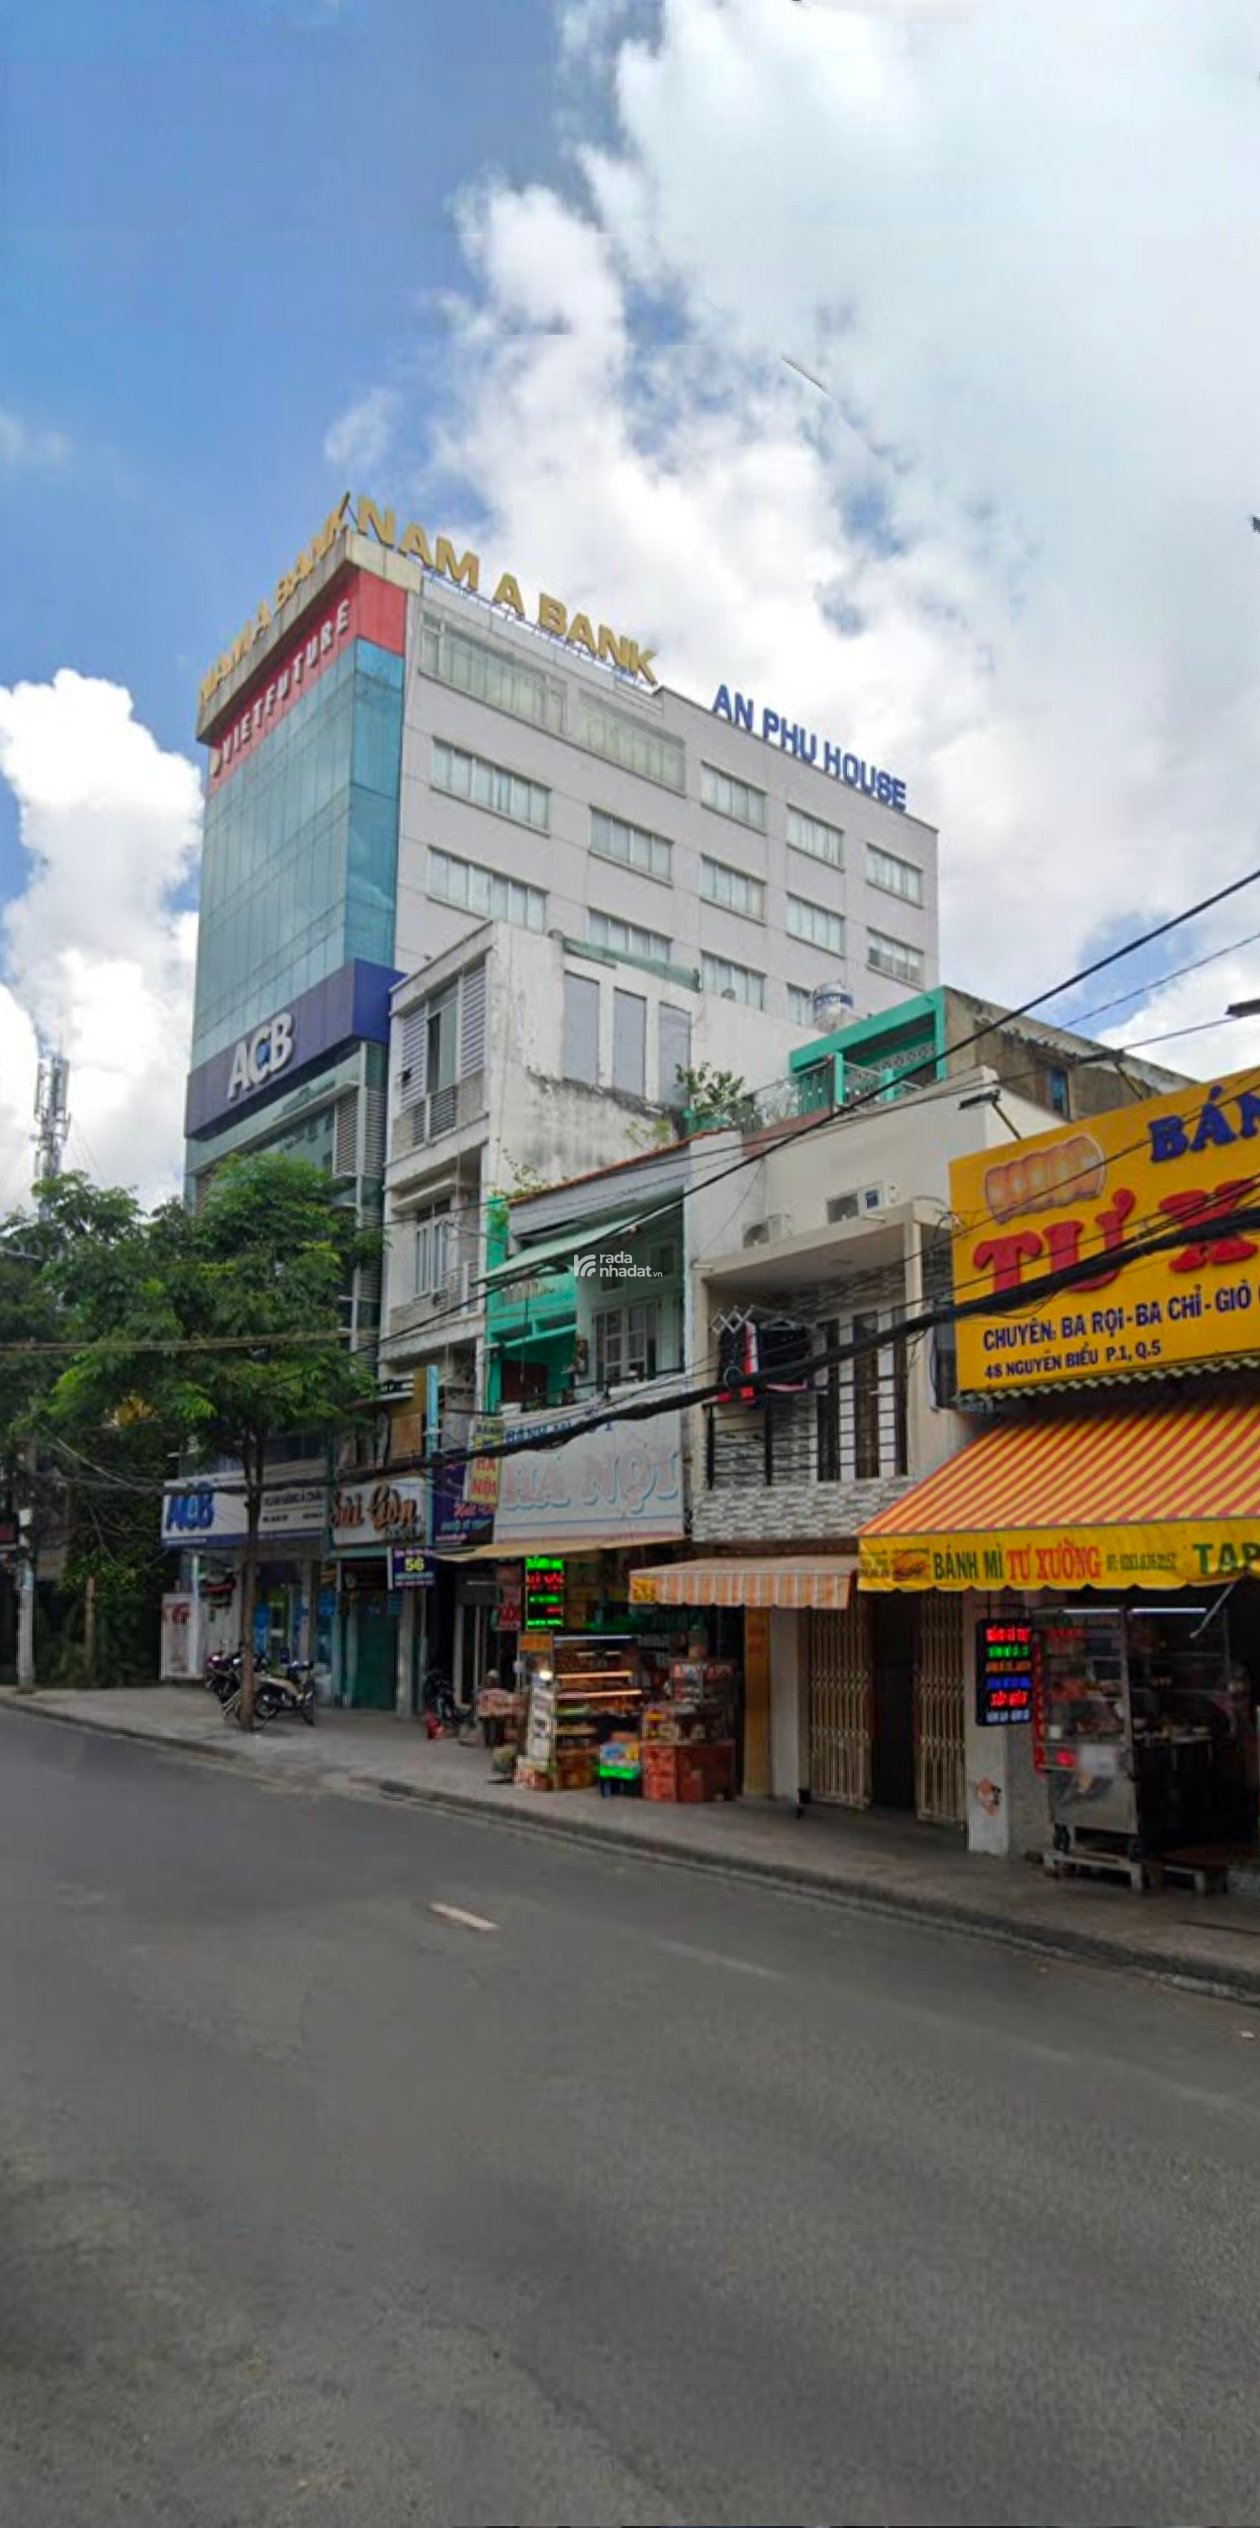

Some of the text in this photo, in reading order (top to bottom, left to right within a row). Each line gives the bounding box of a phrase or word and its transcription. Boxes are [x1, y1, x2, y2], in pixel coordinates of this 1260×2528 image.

[357, 495, 658, 685] NAM A BANK
[220, 598, 352, 765] VIETFUTURE
[713, 683, 908, 813] AN PHU HOUSE
[228, 1012, 296, 1103] ACB
[1062, 1316, 1087, 1339] BA
[1136, 1301, 1162, 1327] BA
[1168, 1284, 1202, 1321] CHỈ
[1215, 1279, 1252, 1313] GIÒ
[934, 1543, 978, 1581] BÁNH
[984, 1543, 1004, 1580] MÌ
[1007, 1543, 1032, 1581] TƯ
